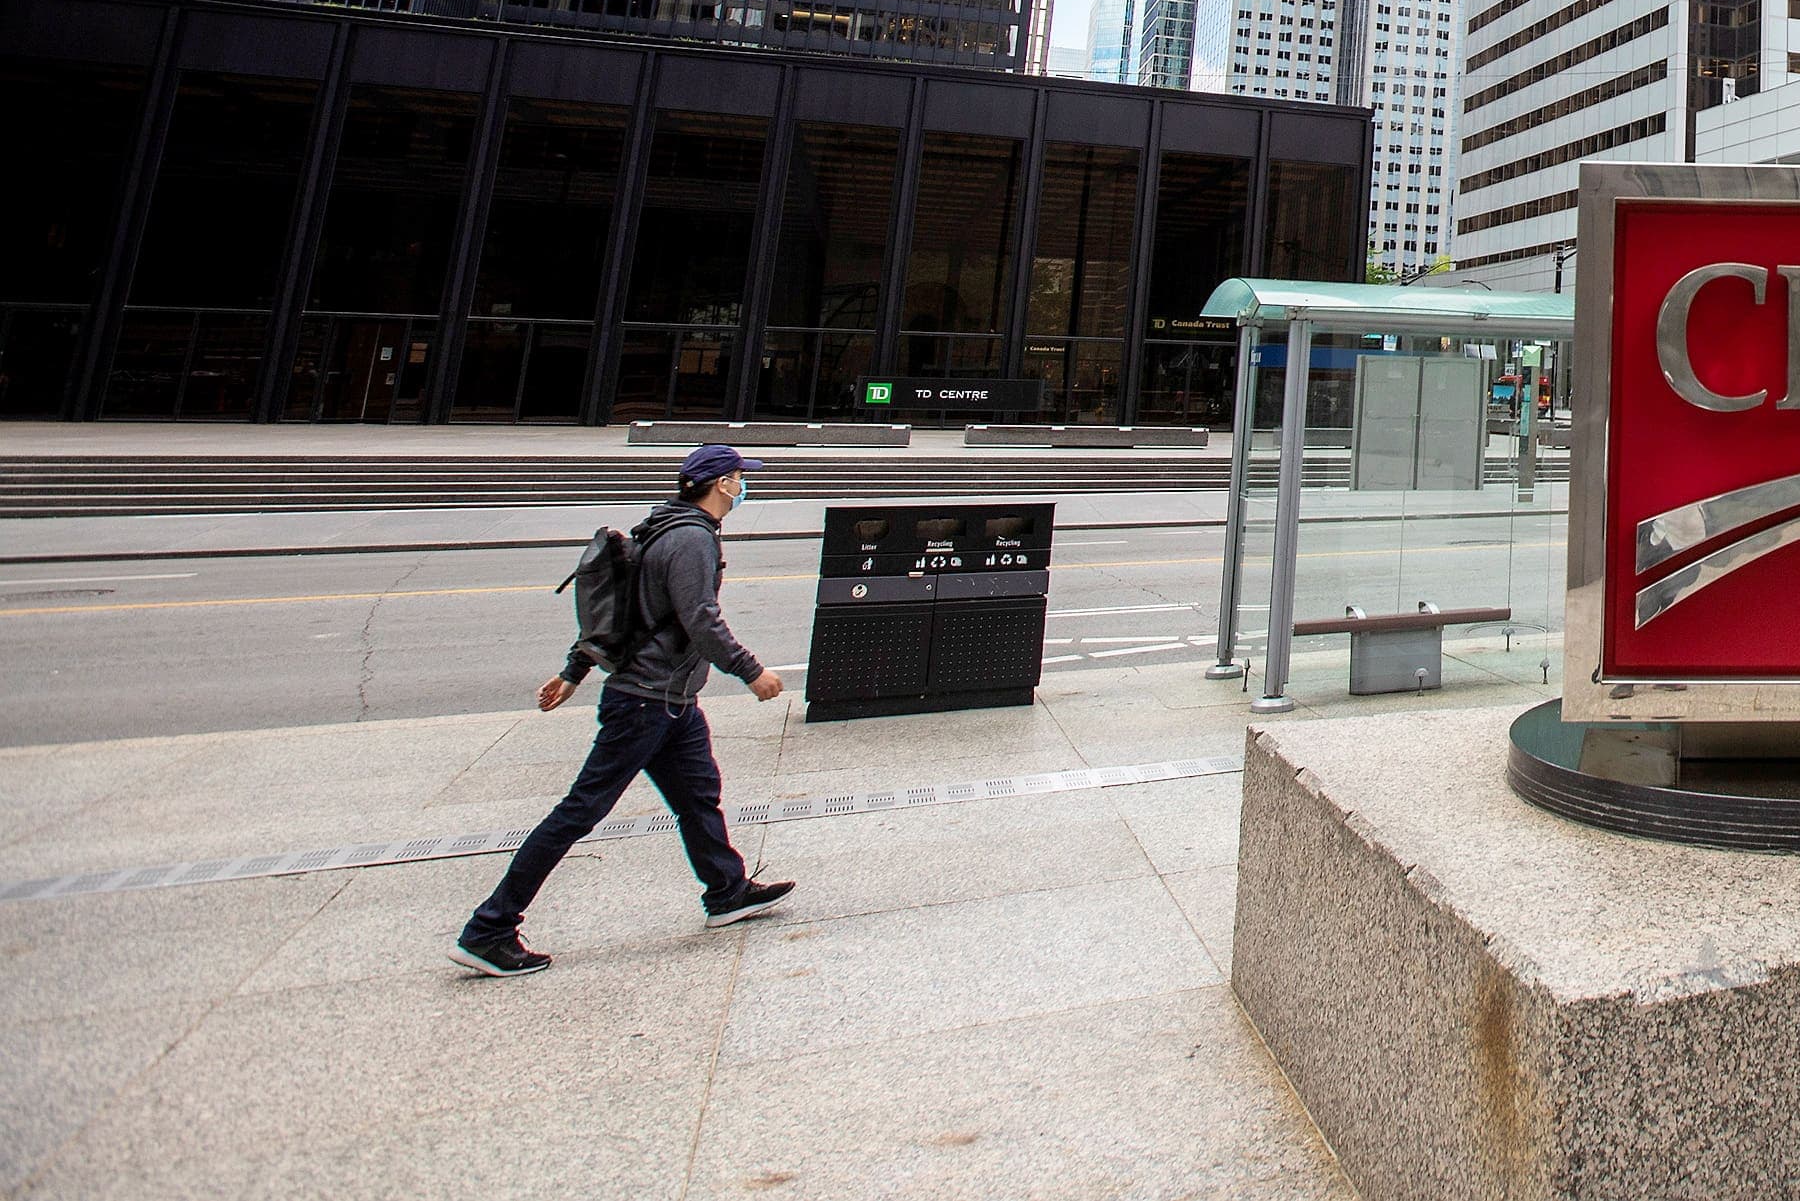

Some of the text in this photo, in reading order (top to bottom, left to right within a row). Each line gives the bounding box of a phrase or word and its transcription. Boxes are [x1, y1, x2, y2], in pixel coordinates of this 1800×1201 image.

[1152, 319, 1230, 329] TD Canada Trust
[869, 386, 889, 400] TD
[915, 390, 989, 400] TD CENTRE
[861, 543, 877, 551] Litter
[927, 540, 953, 548] Recycling
[995, 540, 1021, 548] Recycling
